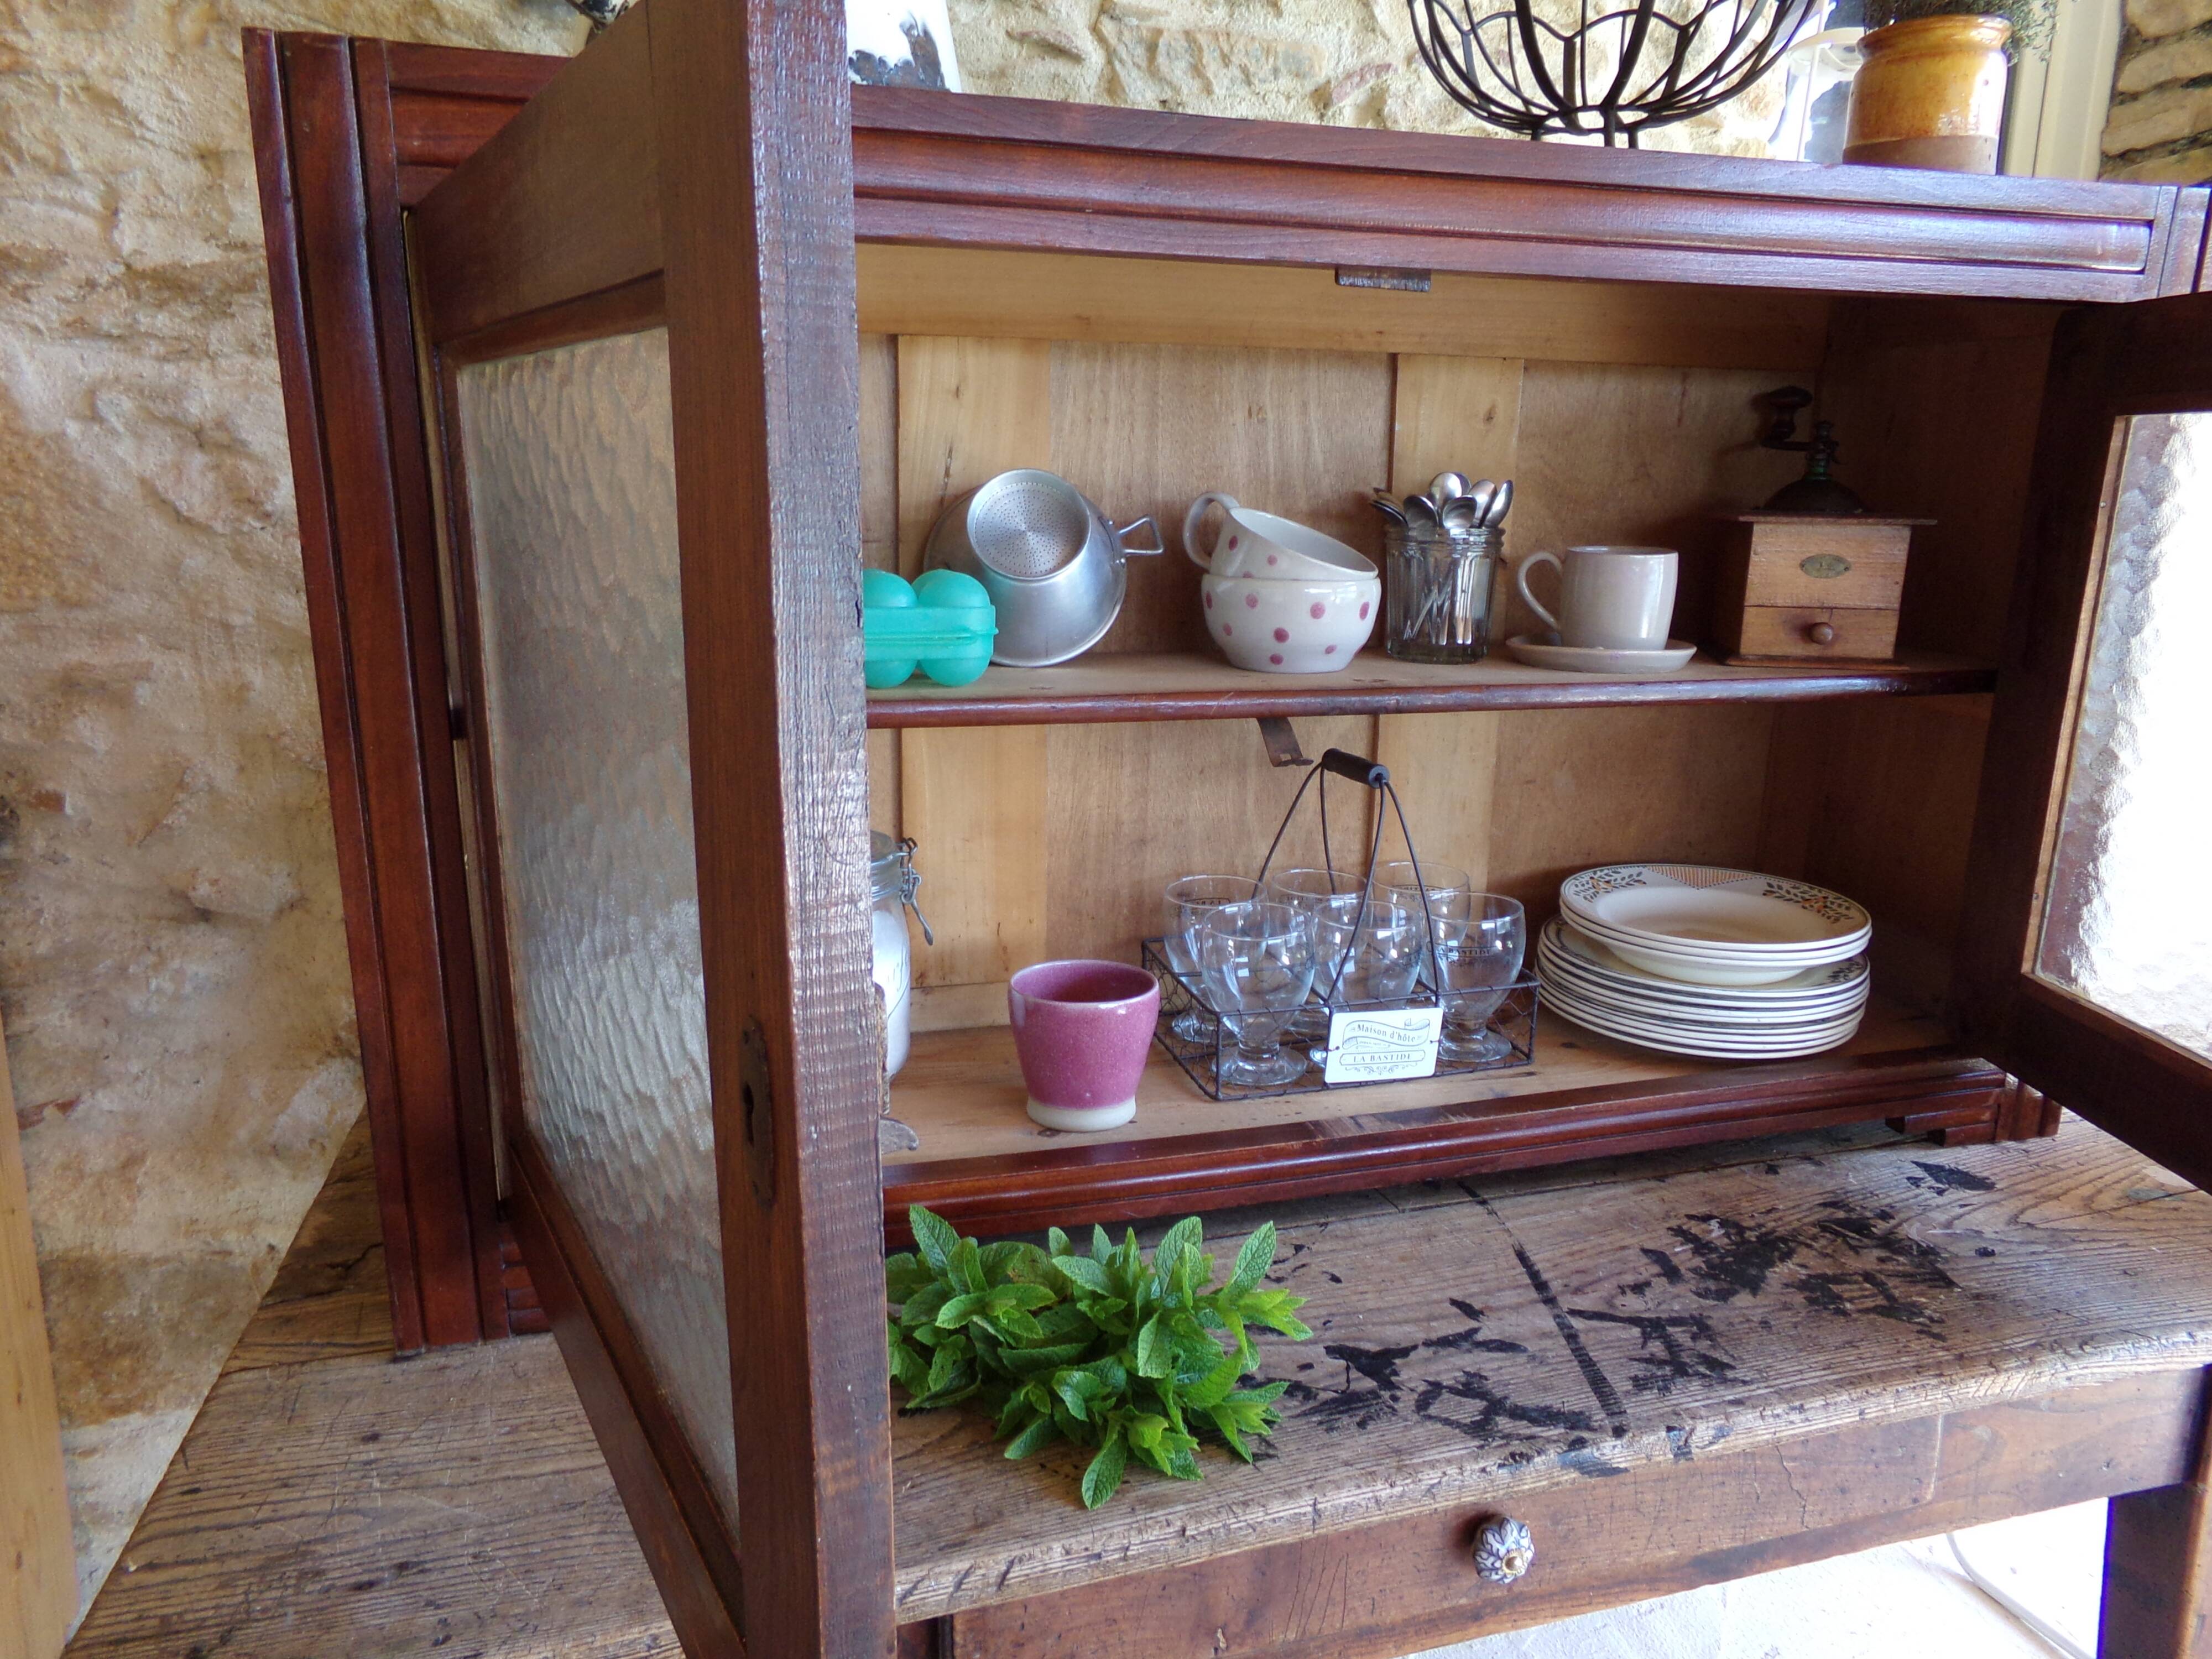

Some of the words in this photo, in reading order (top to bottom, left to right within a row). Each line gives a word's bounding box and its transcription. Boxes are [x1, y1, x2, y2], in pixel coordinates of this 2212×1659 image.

[1357, 1024, 1387, 1037] Maison
[1390, 1030, 1416, 1042] d'hôte
[1370, 1053, 1411, 1062] BASTIDE
